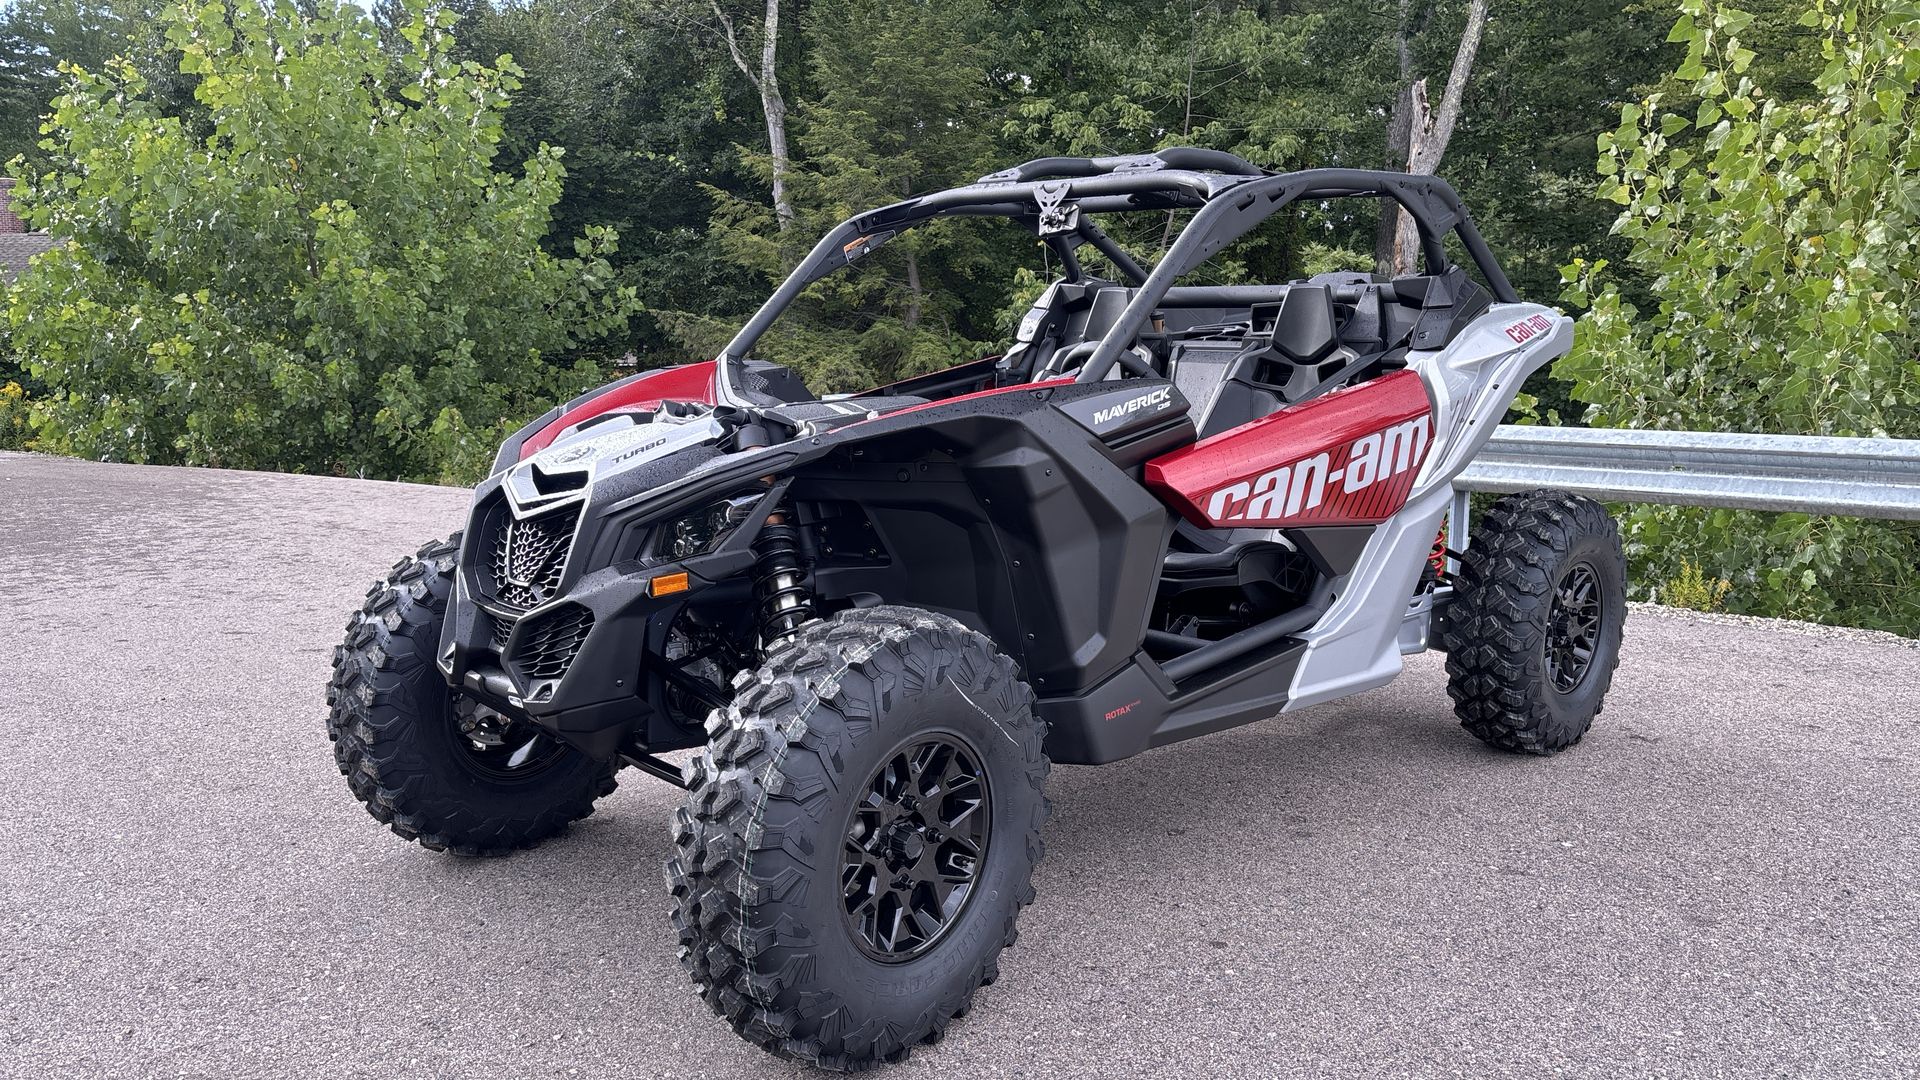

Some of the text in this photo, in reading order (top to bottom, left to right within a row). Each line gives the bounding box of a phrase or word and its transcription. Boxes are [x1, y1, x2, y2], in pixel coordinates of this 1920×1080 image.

[1505, 313, 1553, 344] can-am
[1093, 387, 1171, 425] MAVERICK
[1157, 401, 1171, 411] DS
[612, 438, 667, 464] TURBO
[1207, 415, 1430, 520] can-am
[1104, 704, 1131, 721] ROTAX
